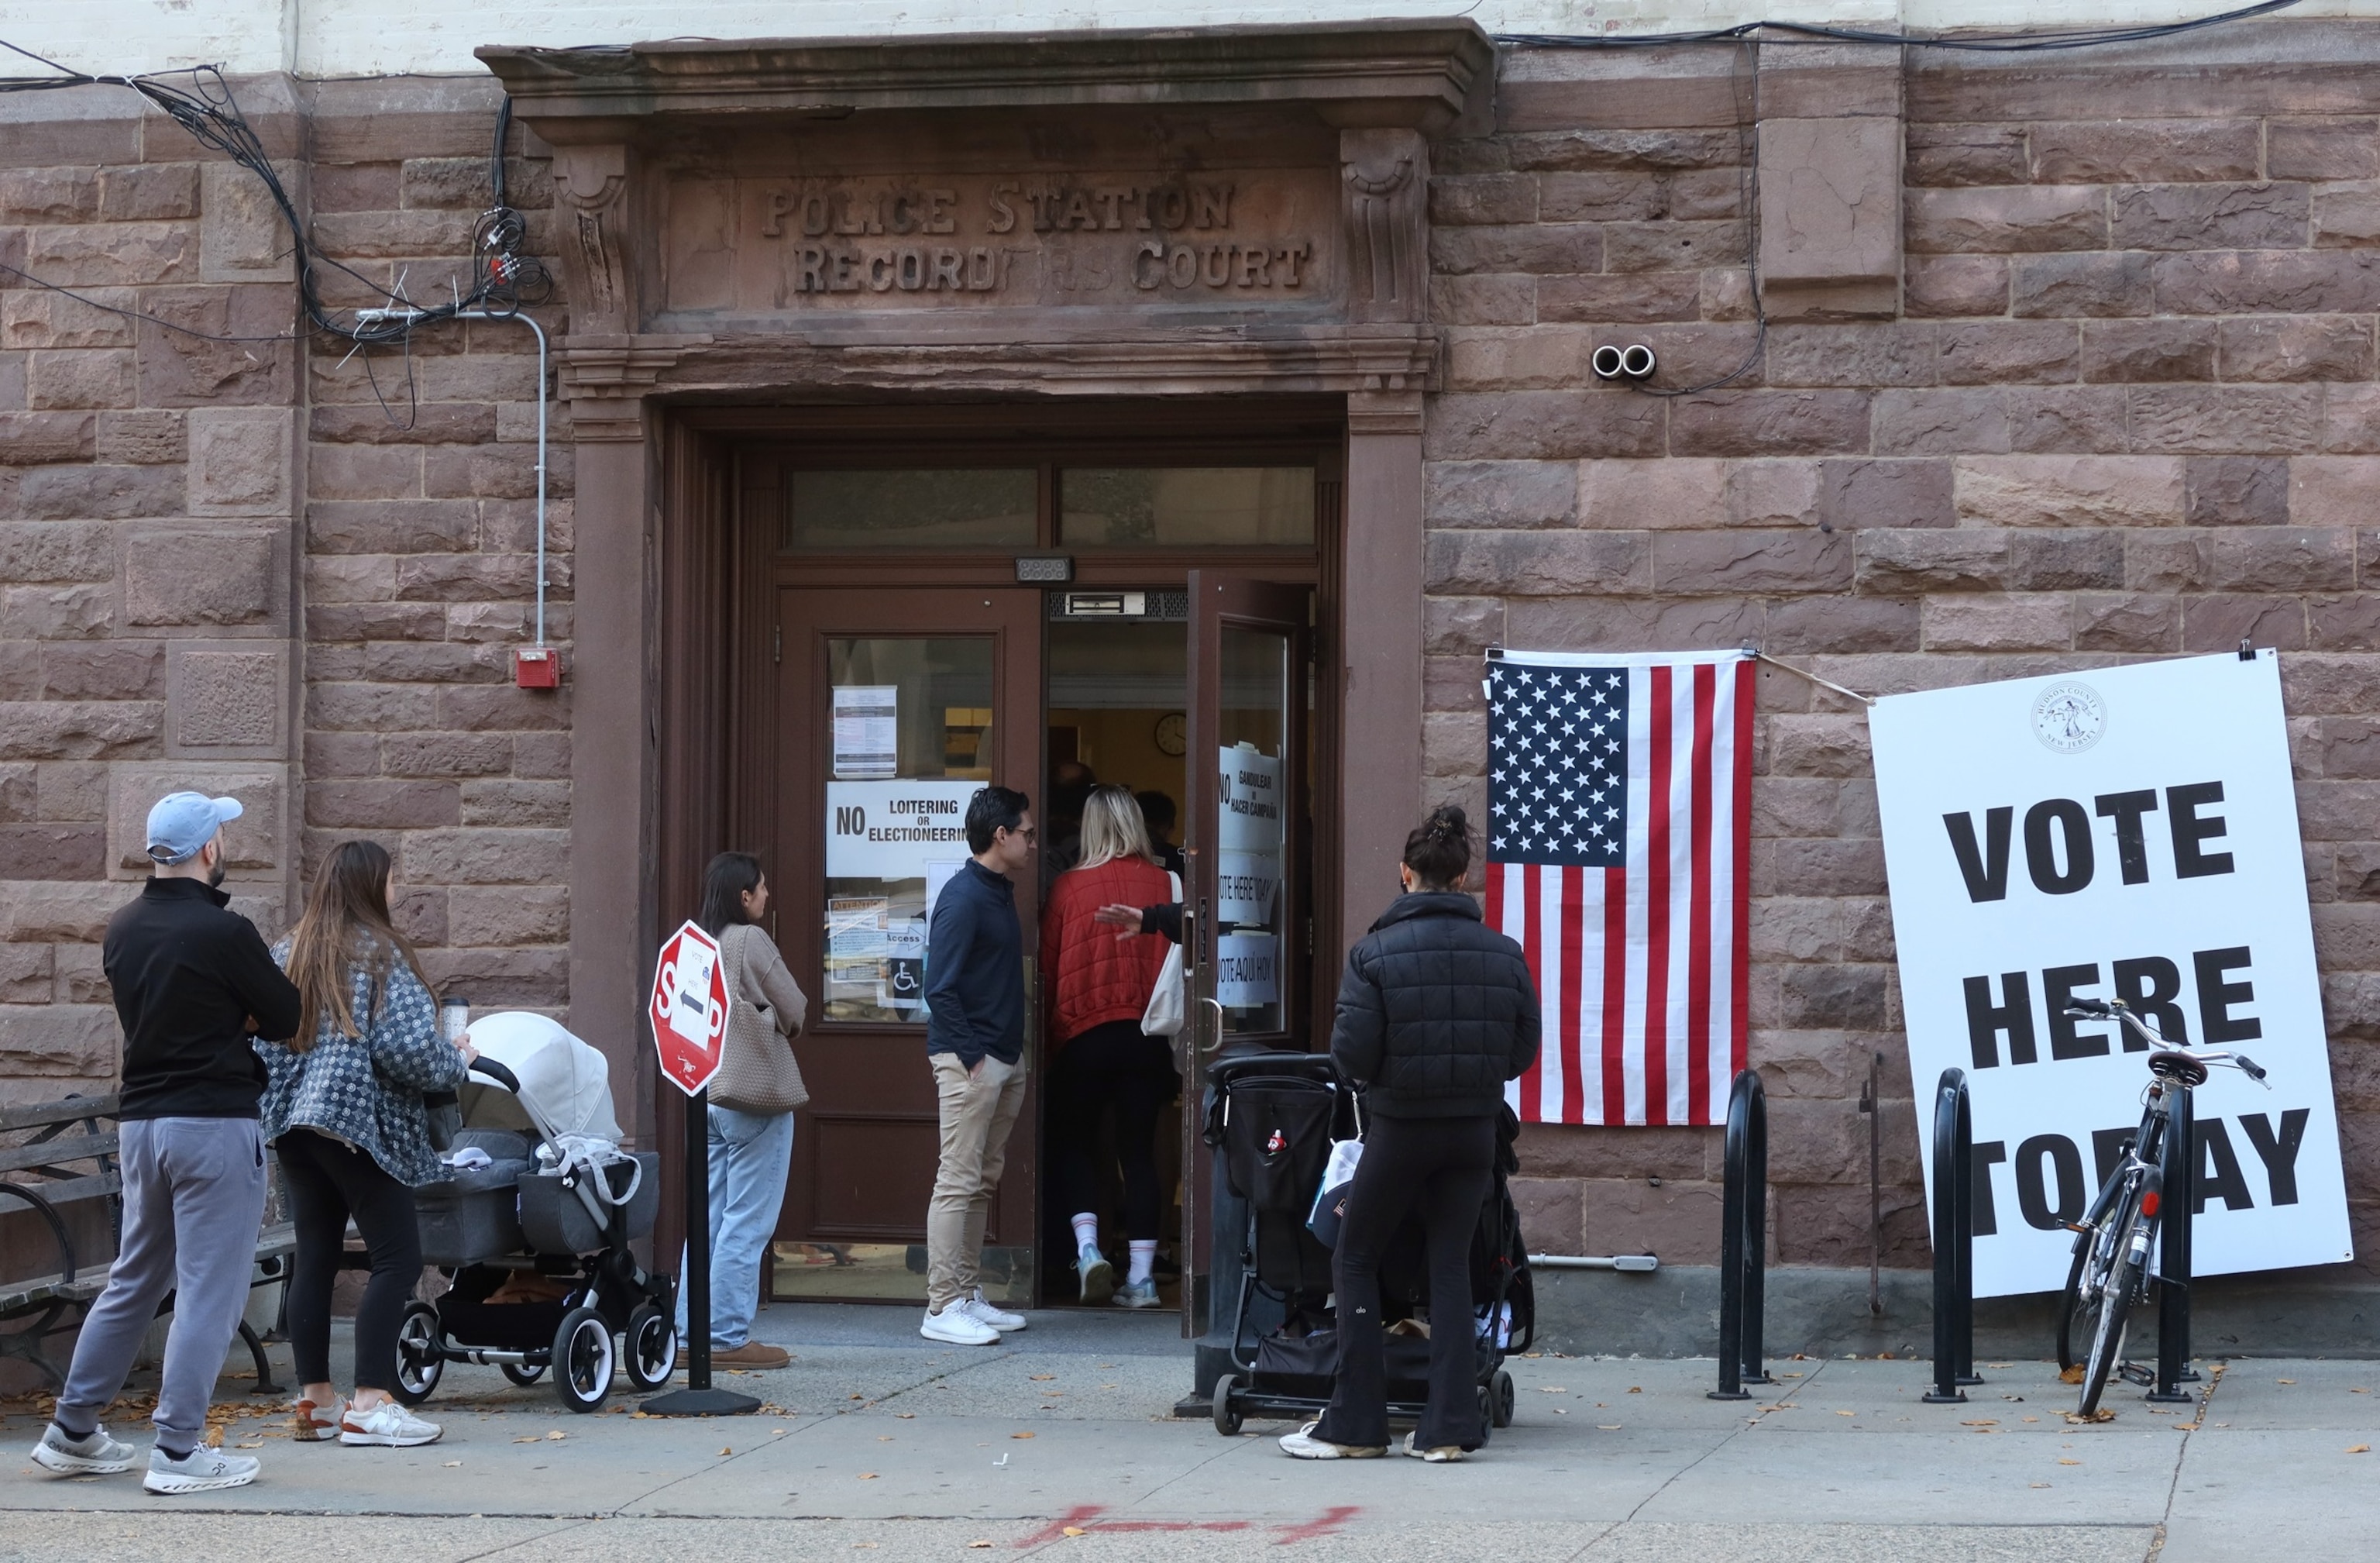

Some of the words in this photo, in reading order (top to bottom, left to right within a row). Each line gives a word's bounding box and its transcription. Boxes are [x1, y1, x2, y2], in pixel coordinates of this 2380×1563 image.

[762, 186, 956, 236] POLICE
[985, 181, 1235, 235] STATION
[1130, 240, 1310, 290] COURT
[2038, 688, 2065, 714] HUDSON
[2068, 687, 2098, 708] COUNTY
[2045, 733, 2063, 746] NEW
[2068, 728, 2096, 749] JERSEY
[1219, 773, 1231, 805] NO
[889, 800, 958, 814] LOITERING
[1230, 797, 1250, 815] HACER
[836, 806, 865, 835] NO
[917, 816, 930, 826] OR
[868, 827, 969, 842] ELECTIONEERIN
[1941, 780, 2236, 904] VOTE
[1219, 874, 1232, 900] OTE
[1233, 876, 1254, 901] HERE
[833, 900, 887, 911] ATTENTION
[887, 934, 920, 942] Access
[691, 949, 703, 964] VOTE
[1235, 950, 1256, 983] AQUÍ
[1257, 955, 1271, 982] HOY
[656, 960, 723, 1038] SP
[1962, 946, 2261, 1069] HERE
[1355, 1306, 1367, 1314] alo
